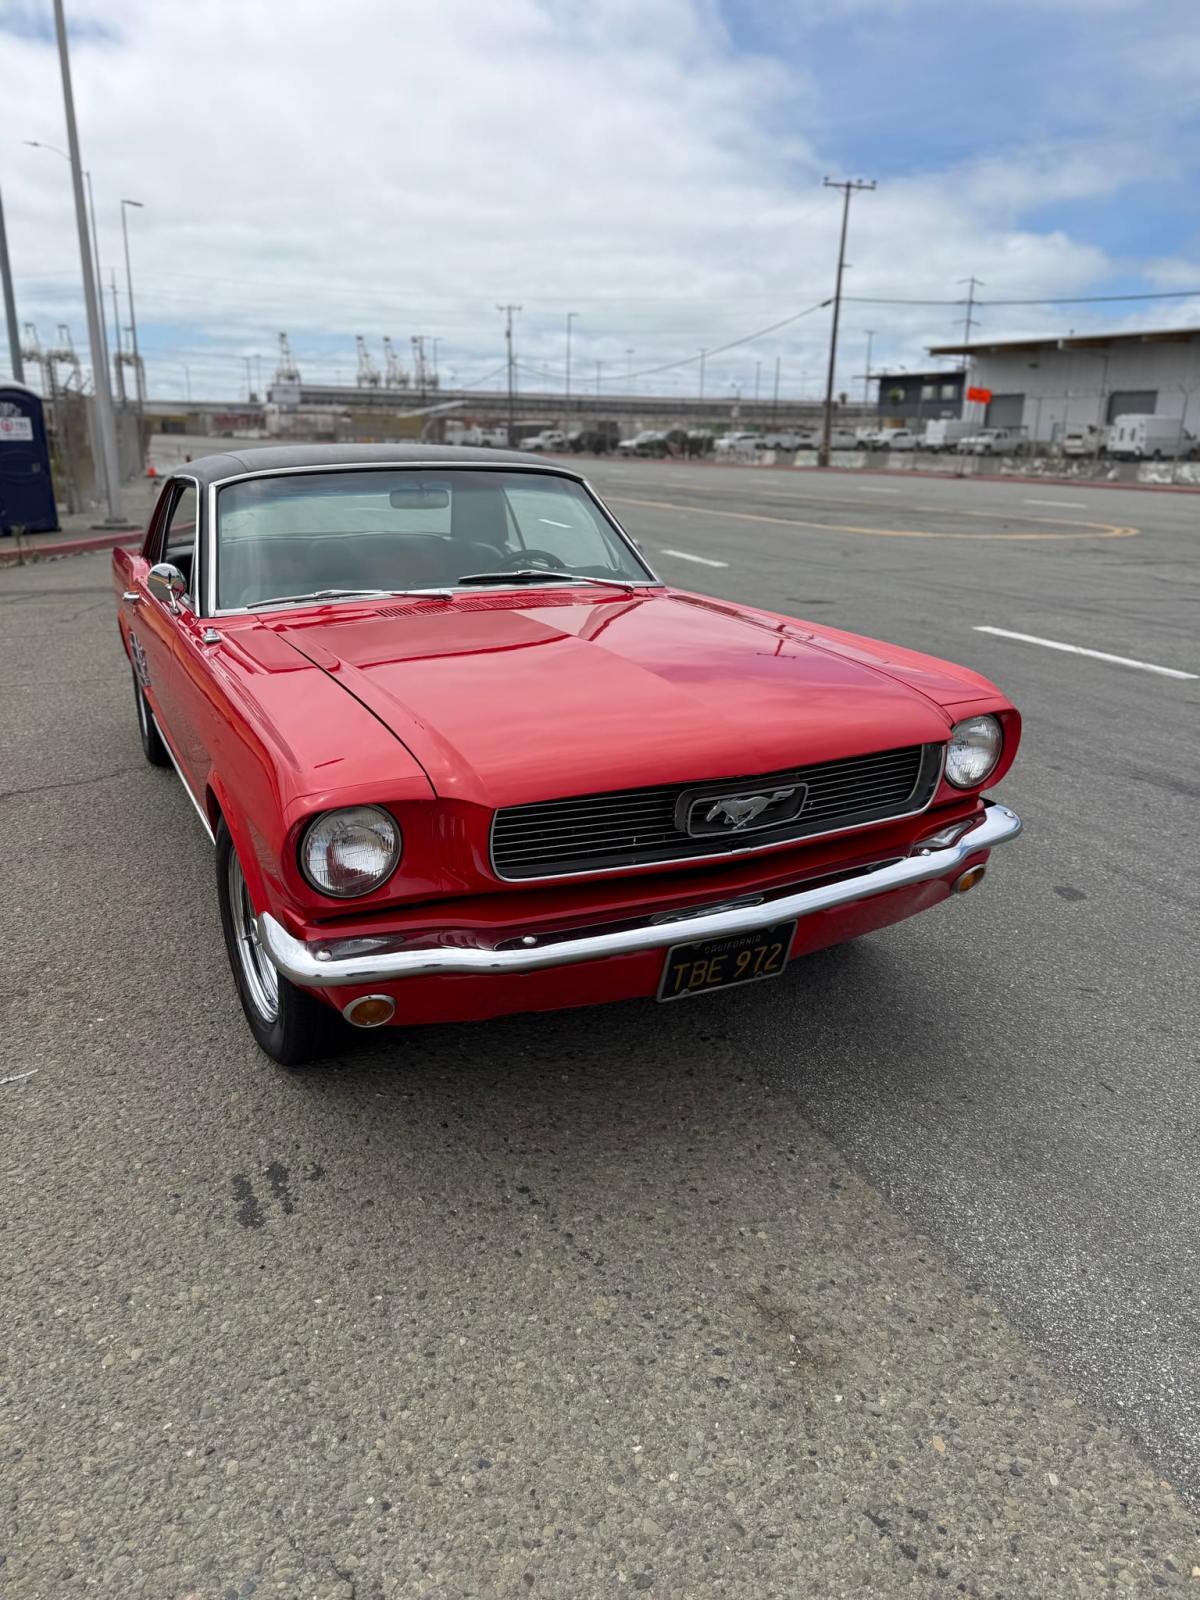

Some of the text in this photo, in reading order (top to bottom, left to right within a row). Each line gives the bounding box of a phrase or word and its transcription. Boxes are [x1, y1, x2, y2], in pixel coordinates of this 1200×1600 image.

[705, 935, 761, 954] CALIFORNIA
[674, 943, 782, 991] TBE 972
